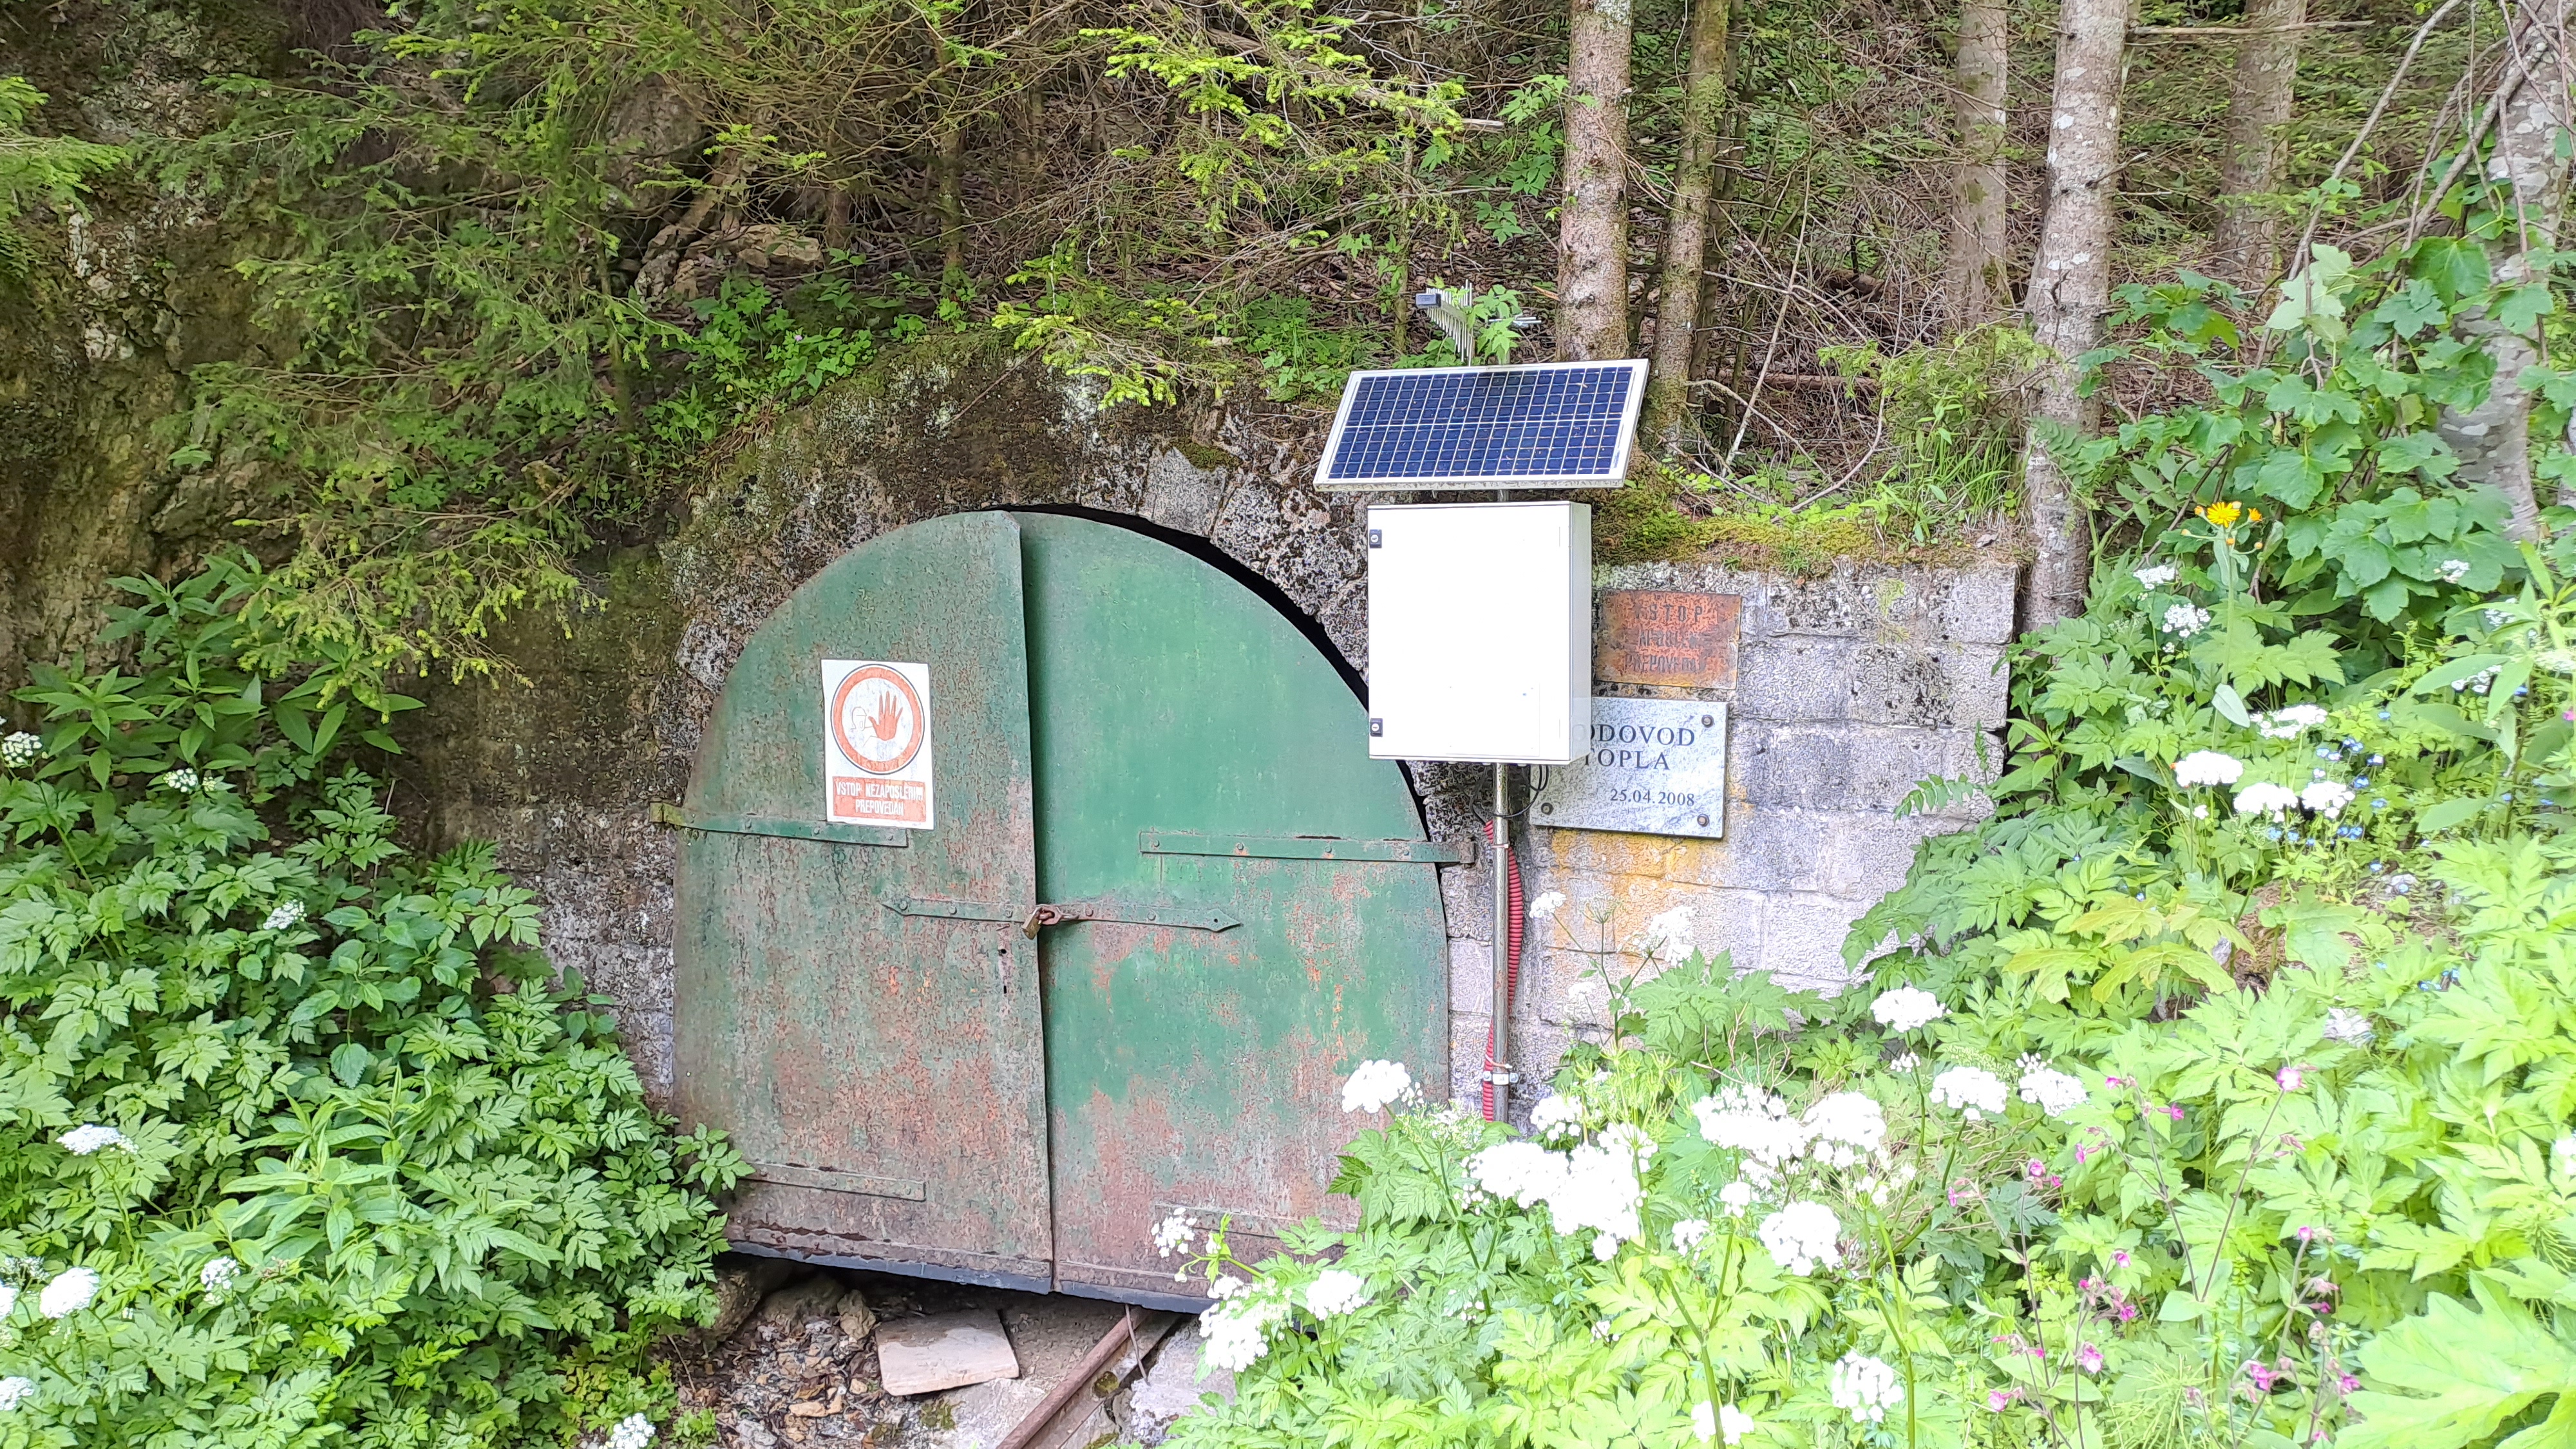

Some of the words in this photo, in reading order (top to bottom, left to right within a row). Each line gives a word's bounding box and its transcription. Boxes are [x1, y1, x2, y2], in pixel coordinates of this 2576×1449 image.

[1591, 723, 1695, 746] DOVOD
[835, 781, 861, 797] VSTOP
[1610, 788, 1695, 806] 25.04.2008
[855, 799, 904, 816] PREPOVEDAN
